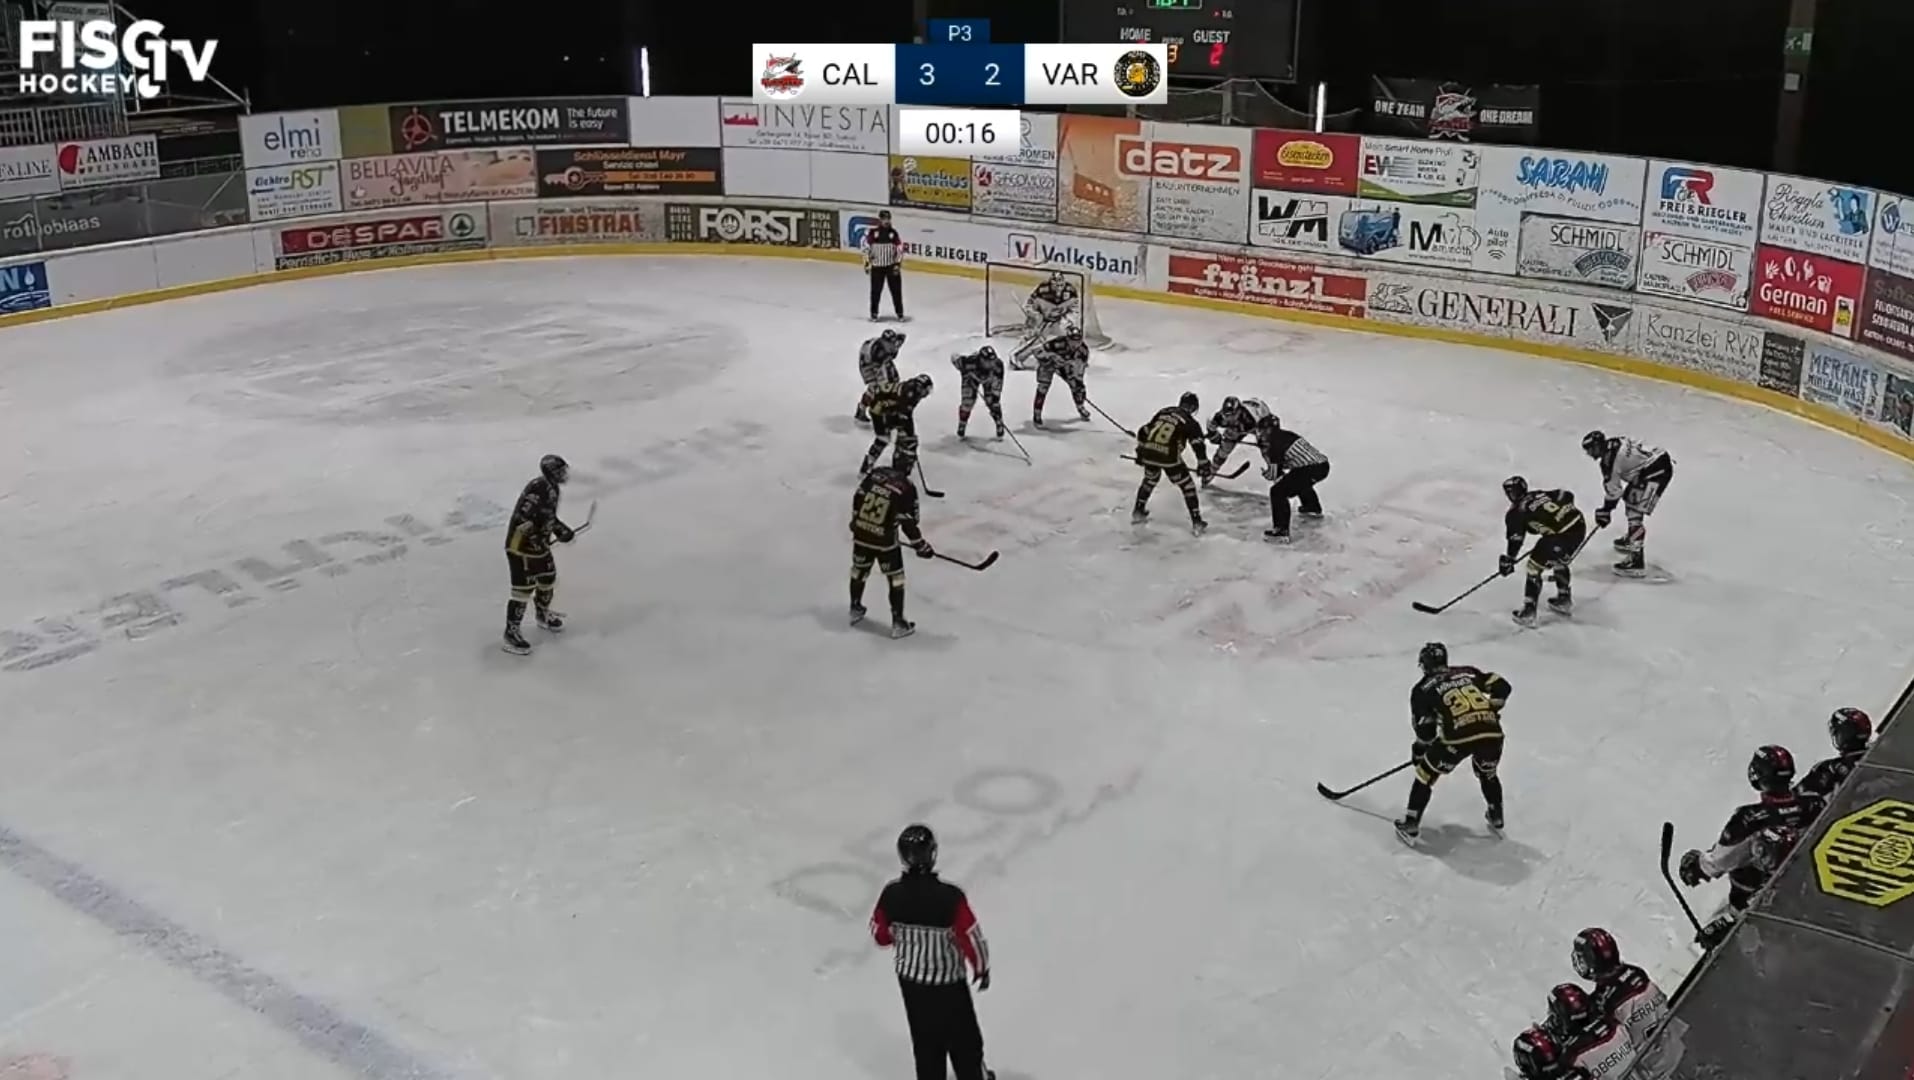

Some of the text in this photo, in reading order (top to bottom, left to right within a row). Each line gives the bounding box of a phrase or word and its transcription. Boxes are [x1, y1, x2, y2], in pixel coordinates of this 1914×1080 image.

[1120, 28, 1151, 41] HOME
[1193, 30, 1230, 43] GUEST
[1210, 43, 1226, 66] 2
[440, 107, 560, 134] TELMEKOM
[567, 106, 618, 118] The future
[764, 104, 886, 133] INVESTA
[1374, 100, 1425, 118] ONE TEAM
[1480, 110, 1533, 124] ONE DREAM
[264, 116, 321, 150] elmi
[569, 119, 604, 131] is easy
[1125, 142, 1240, 180] datz
[1385, 144, 1409, 153] Smart
[1410, 145, 1434, 155] Home
[906, 168, 968, 189] markus
[1516, 156, 1609, 196] SARAH
[537, 213, 646, 235] FINSTRAL
[700, 207, 805, 242] FORST
[1660, 201, 1747, 223] FREI & RIEGLER
[306, 219, 441, 248] DESPAR
[1487, 227, 1510, 238] Auto
[1487, 238, 1508, 248] pilot
[1550, 225, 1625, 251] SCHMIDL
[925, 244, 933, 256] &
[935, 246, 989, 263] RIEGLER
[1661, 240, 1736, 272] SCHMIDL
[1203, 263, 1324, 302] fränzl
[1760, 282, 1827, 317] German
[1416, 288, 1580, 338] GENERALI
[1648, 313, 1760, 359] Kanzlei RVR
[1809, 352, 1879, 395] MERANER
[859, 491, 891, 525] 23
